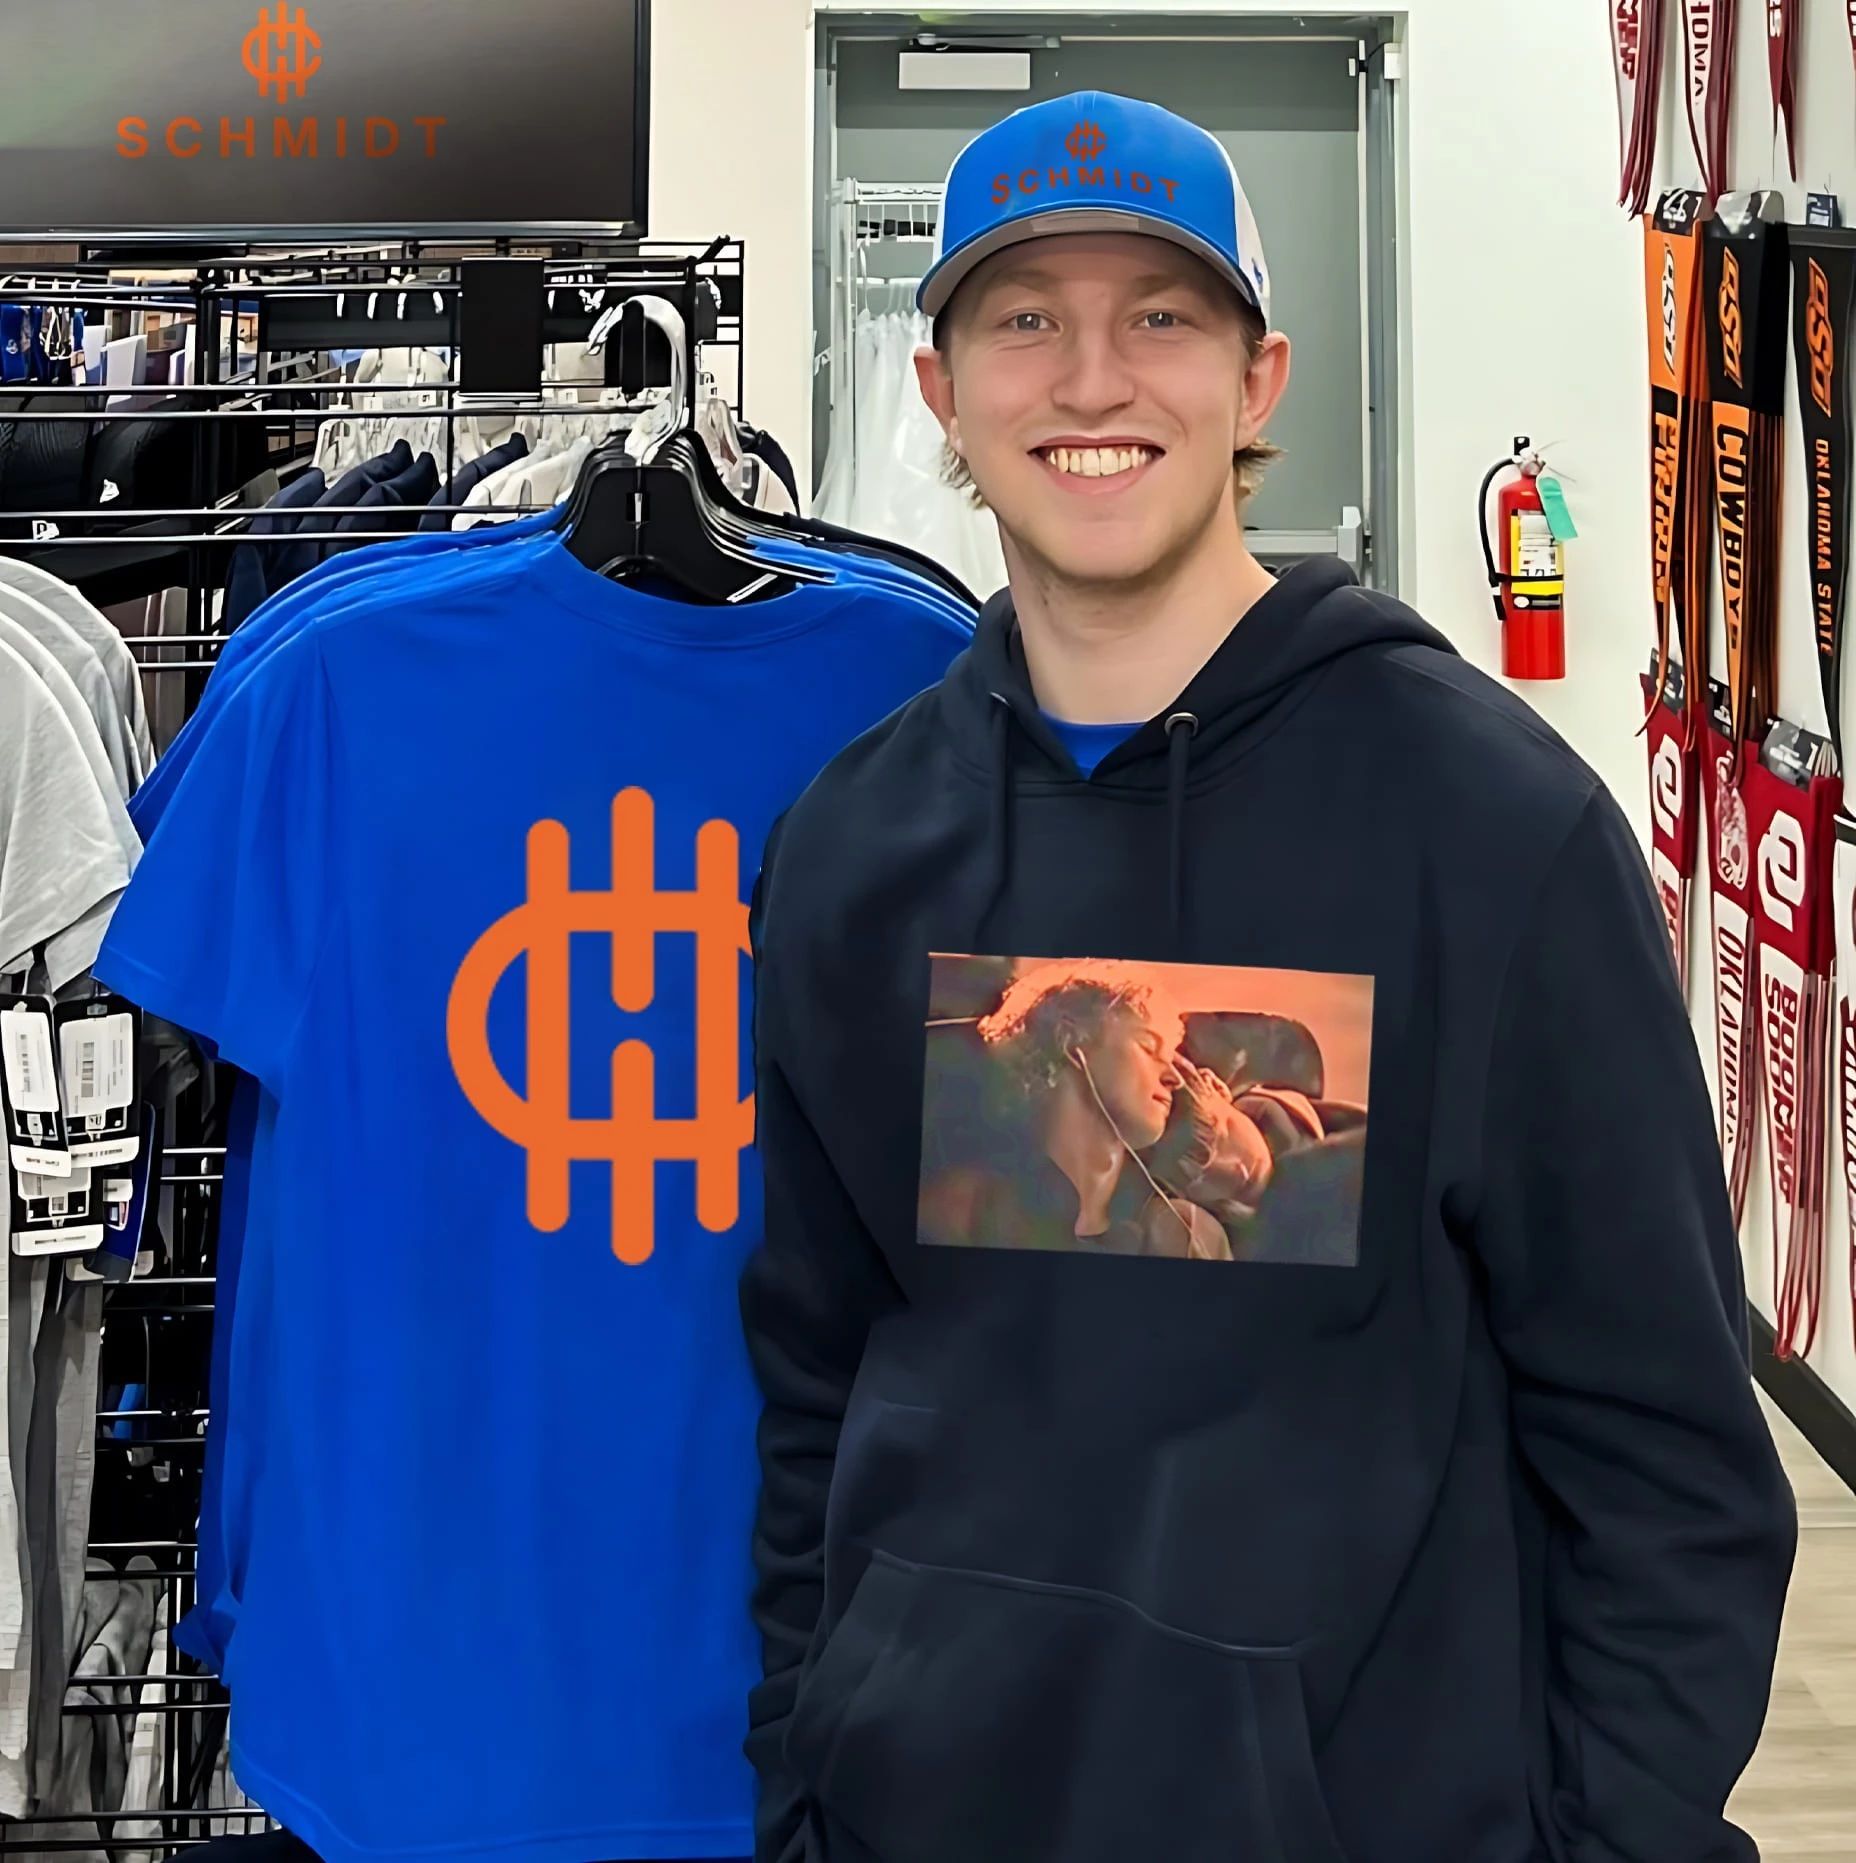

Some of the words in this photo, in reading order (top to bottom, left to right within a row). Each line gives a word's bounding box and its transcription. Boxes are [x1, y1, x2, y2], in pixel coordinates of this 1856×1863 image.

[114, 115, 447, 159] SCHMIDT
[991, 166, 1181, 205] SCHMIDT
[1815, 438, 1831, 570] OKLAHOMA
[1717, 925, 1745, 1145] OKLAHOMA
